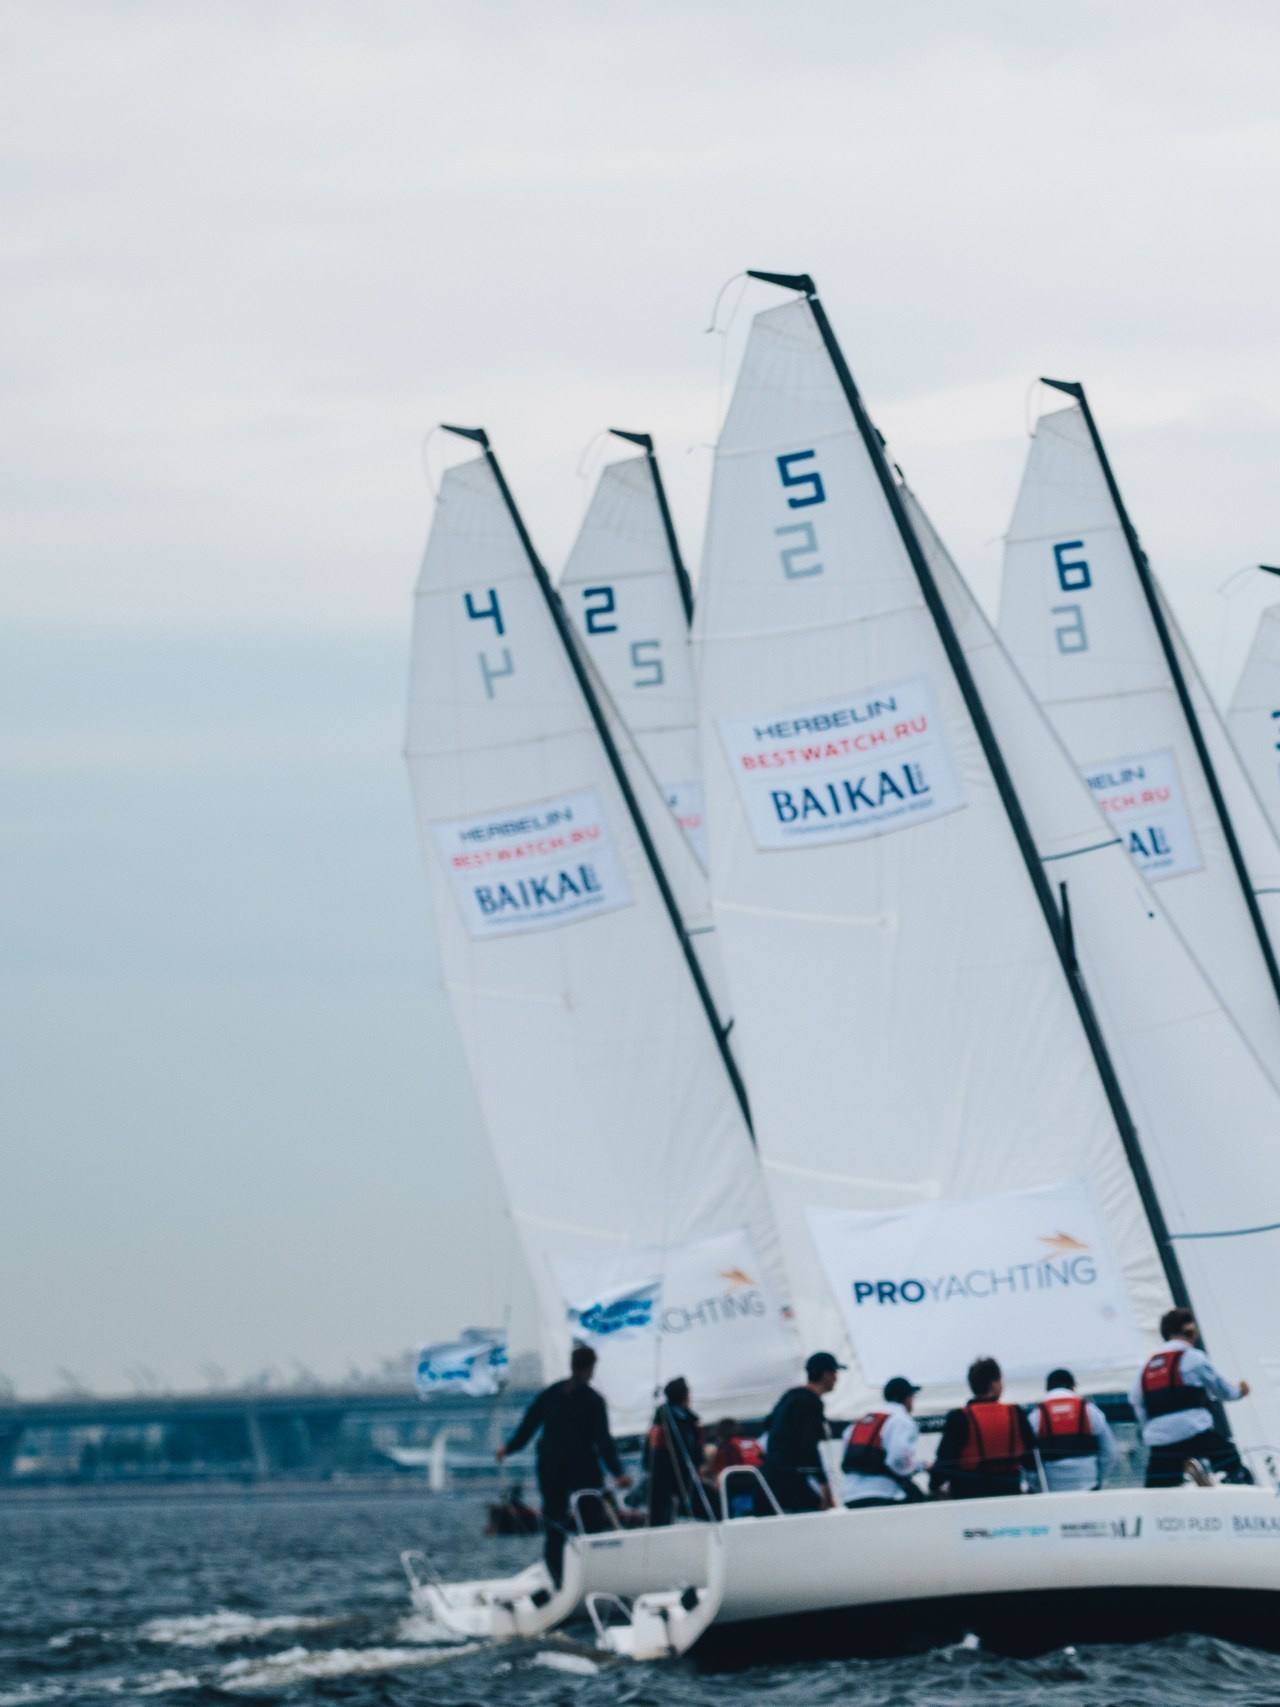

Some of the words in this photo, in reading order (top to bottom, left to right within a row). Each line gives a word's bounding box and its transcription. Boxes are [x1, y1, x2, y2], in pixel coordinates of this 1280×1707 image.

[776, 449, 826, 510] 5
[1052, 540, 1092, 592] 6
[463, 588, 505, 636] 4
[582, 586, 619, 634] 2
[753, 695, 898, 741] HERBELIN
[740, 715, 929, 772] BESTWATCH.RU
[770, 763, 931, 824] BAIKAL
[452, 824, 601, 869] BESTWATCH.RU
[458, 806, 574, 843] HERBELIN
[474, 863, 603, 915] BAIKAL
[853, 1255, 1098, 1305] PROYACHTING
[660, 1290, 766, 1335] CHTING
